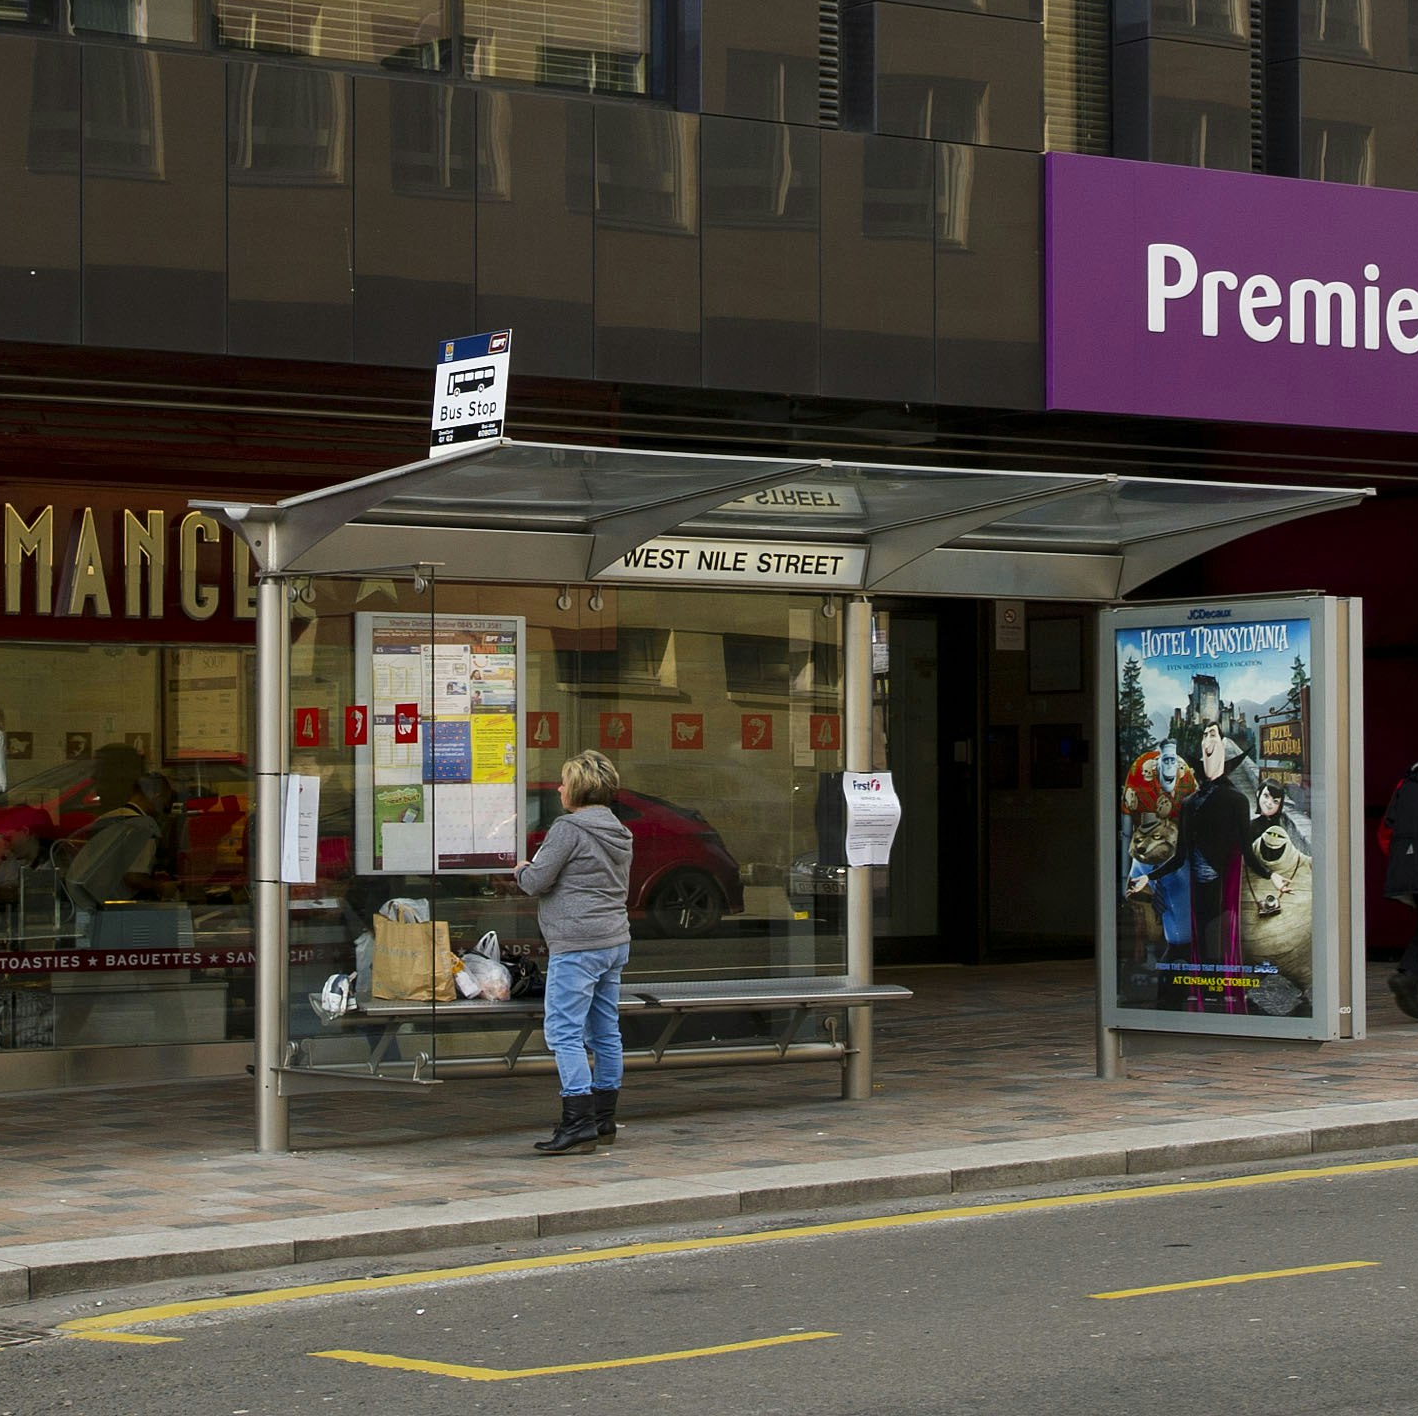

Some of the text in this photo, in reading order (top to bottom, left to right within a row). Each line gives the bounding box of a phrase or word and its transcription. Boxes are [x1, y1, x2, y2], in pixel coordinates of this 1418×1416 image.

[440, 400, 497, 422] Bus Stop
[4, 501, 316, 621] MANGE
[622, 547, 844, 577] WEST NILE STREET
[1187, 609, 1232, 620] JCDecaux
[1141, 624, 1290, 659] HOTEL TRANSYLVANIA
[105, 952, 202, 967] BAGUETTES
[1172, 976, 1182, 985] AT
[1183, 976, 1216, 986] CINEMAS
[1216, 977, 1252, 987] OCTOBER
